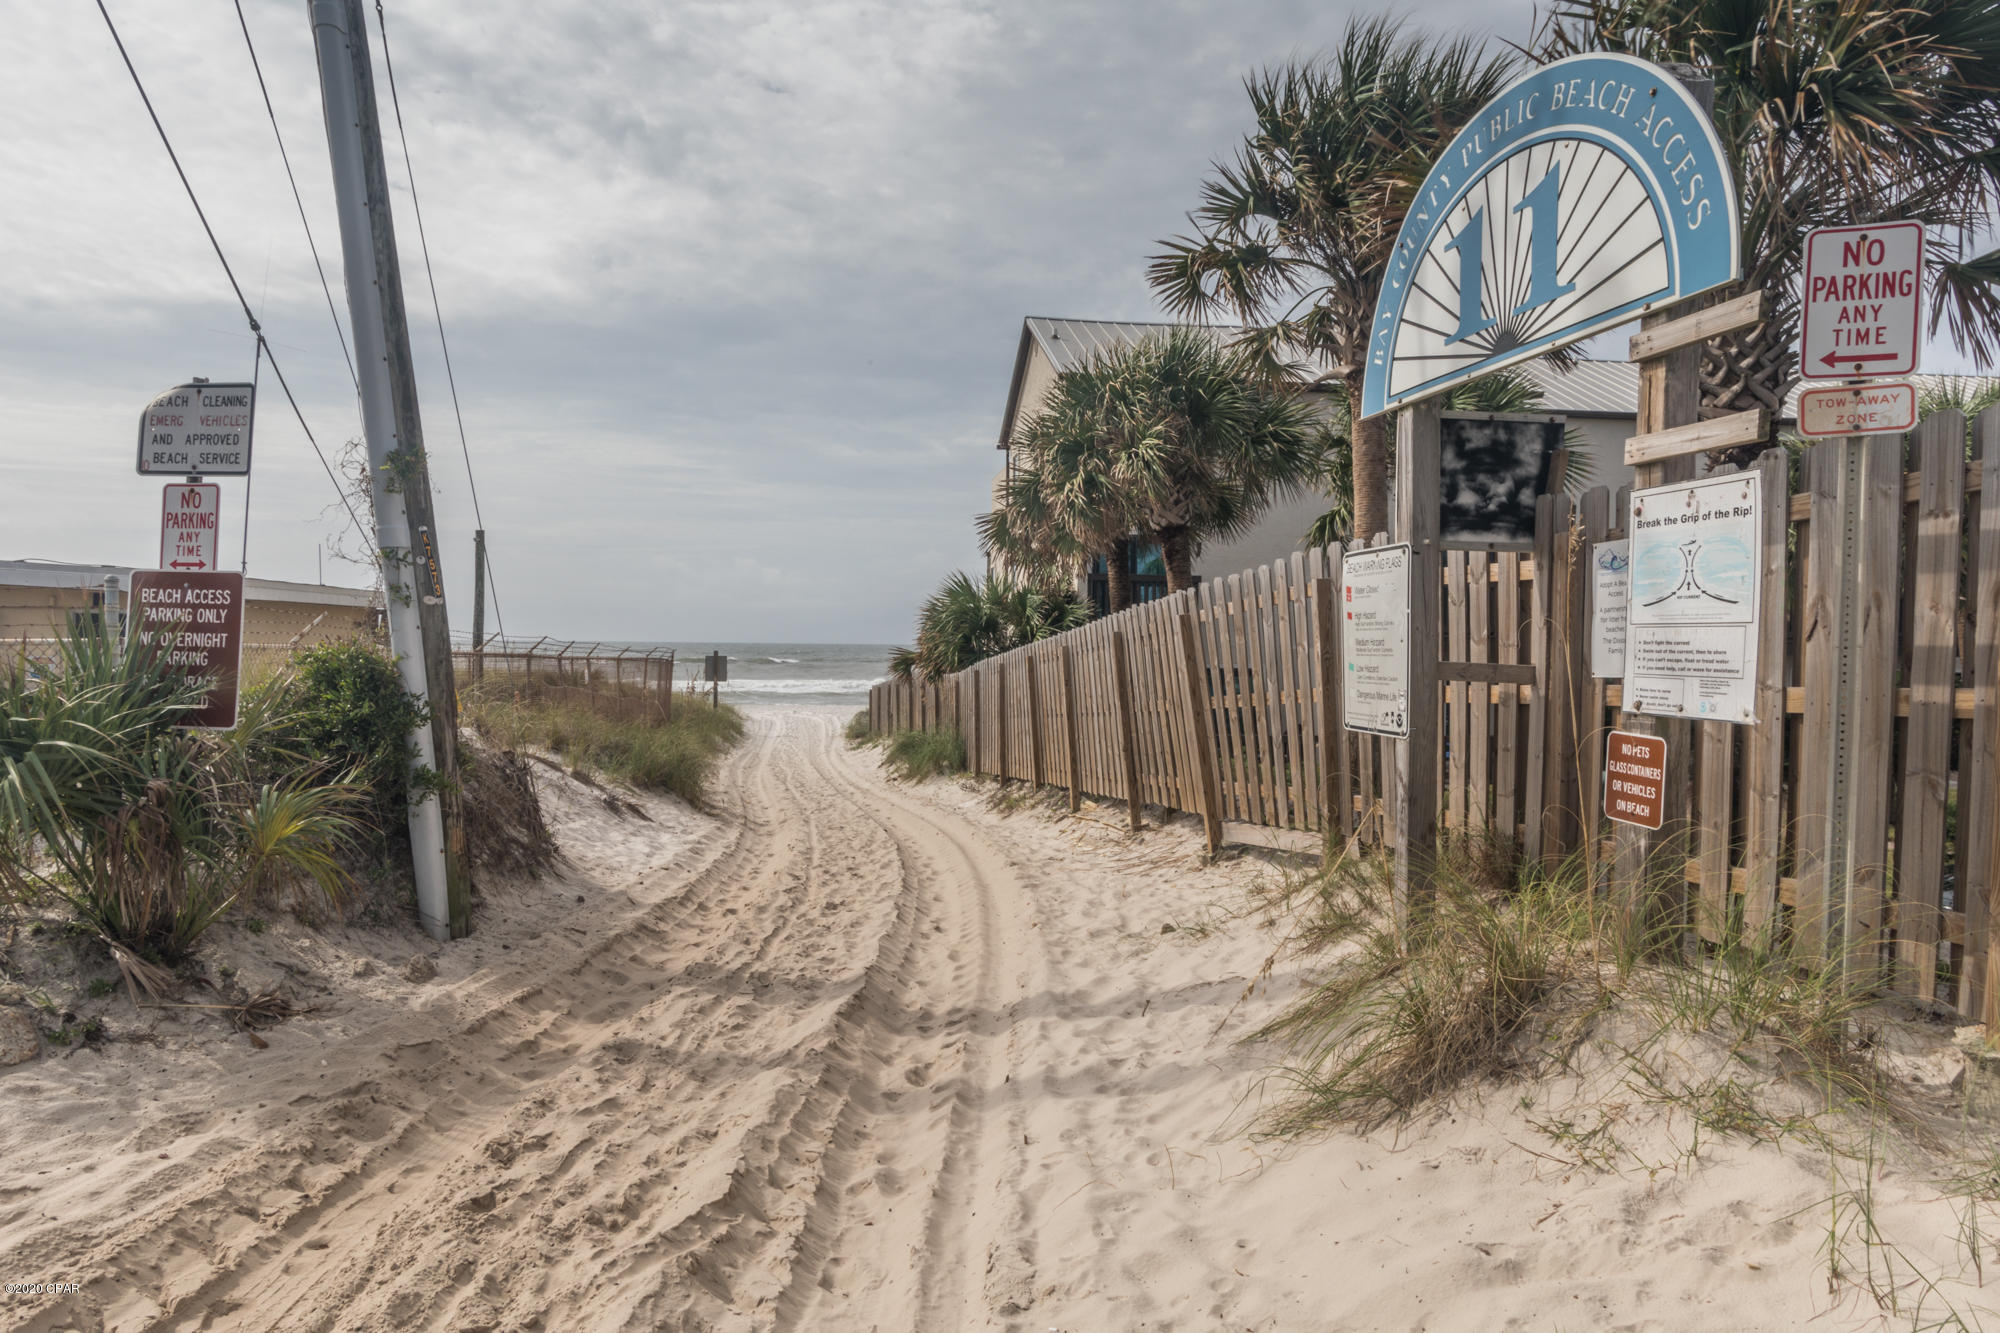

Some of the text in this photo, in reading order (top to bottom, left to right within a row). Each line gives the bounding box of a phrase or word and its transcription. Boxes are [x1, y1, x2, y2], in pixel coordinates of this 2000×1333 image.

[1374, 79, 1711, 365] BAY COUNTY PUBLIC BEACH ACCESS
[1444, 158, 1576, 346] 11
[1842, 239, 1885, 268] NO
[1812, 269, 1913, 303] PARKING
[1837, 303, 1883, 324] ANY
[1832, 326, 1887, 347] TIME
[152, 395, 248, 408] BEACH CLEANING
[1816, 393, 1900, 409] TOW-AWAY
[150, 415, 248, 427] EMERG VEHICLES
[1836, 412, 1878, 425] ZONE
[152, 433, 240, 446] AND APPROVED
[153, 452, 188, 464] BEACH
[200, 452, 240, 464] SERVICE
[181, 492, 202, 508] NO
[166, 512, 214, 529] PARKING
[1637, 505, 1753, 530] Break the Grip of the Rip!
[178, 531, 201, 543] ANY
[176, 544, 202, 557] TIME
[1363, 558, 1384, 571] WARNING
[1385, 556, 1402, 568] FLAGS
[142, 588, 231, 604] BEACH ACCESS
[144, 607, 228, 624] PARKING ONLY
[1622, 744, 1650, 759] NO PETS
[1609, 760, 1662, 780] GLASS CONTAINERS
[1612, 780, 1656, 799] OR VEHICLES
[1616, 800, 1650, 816] ON BEACH
